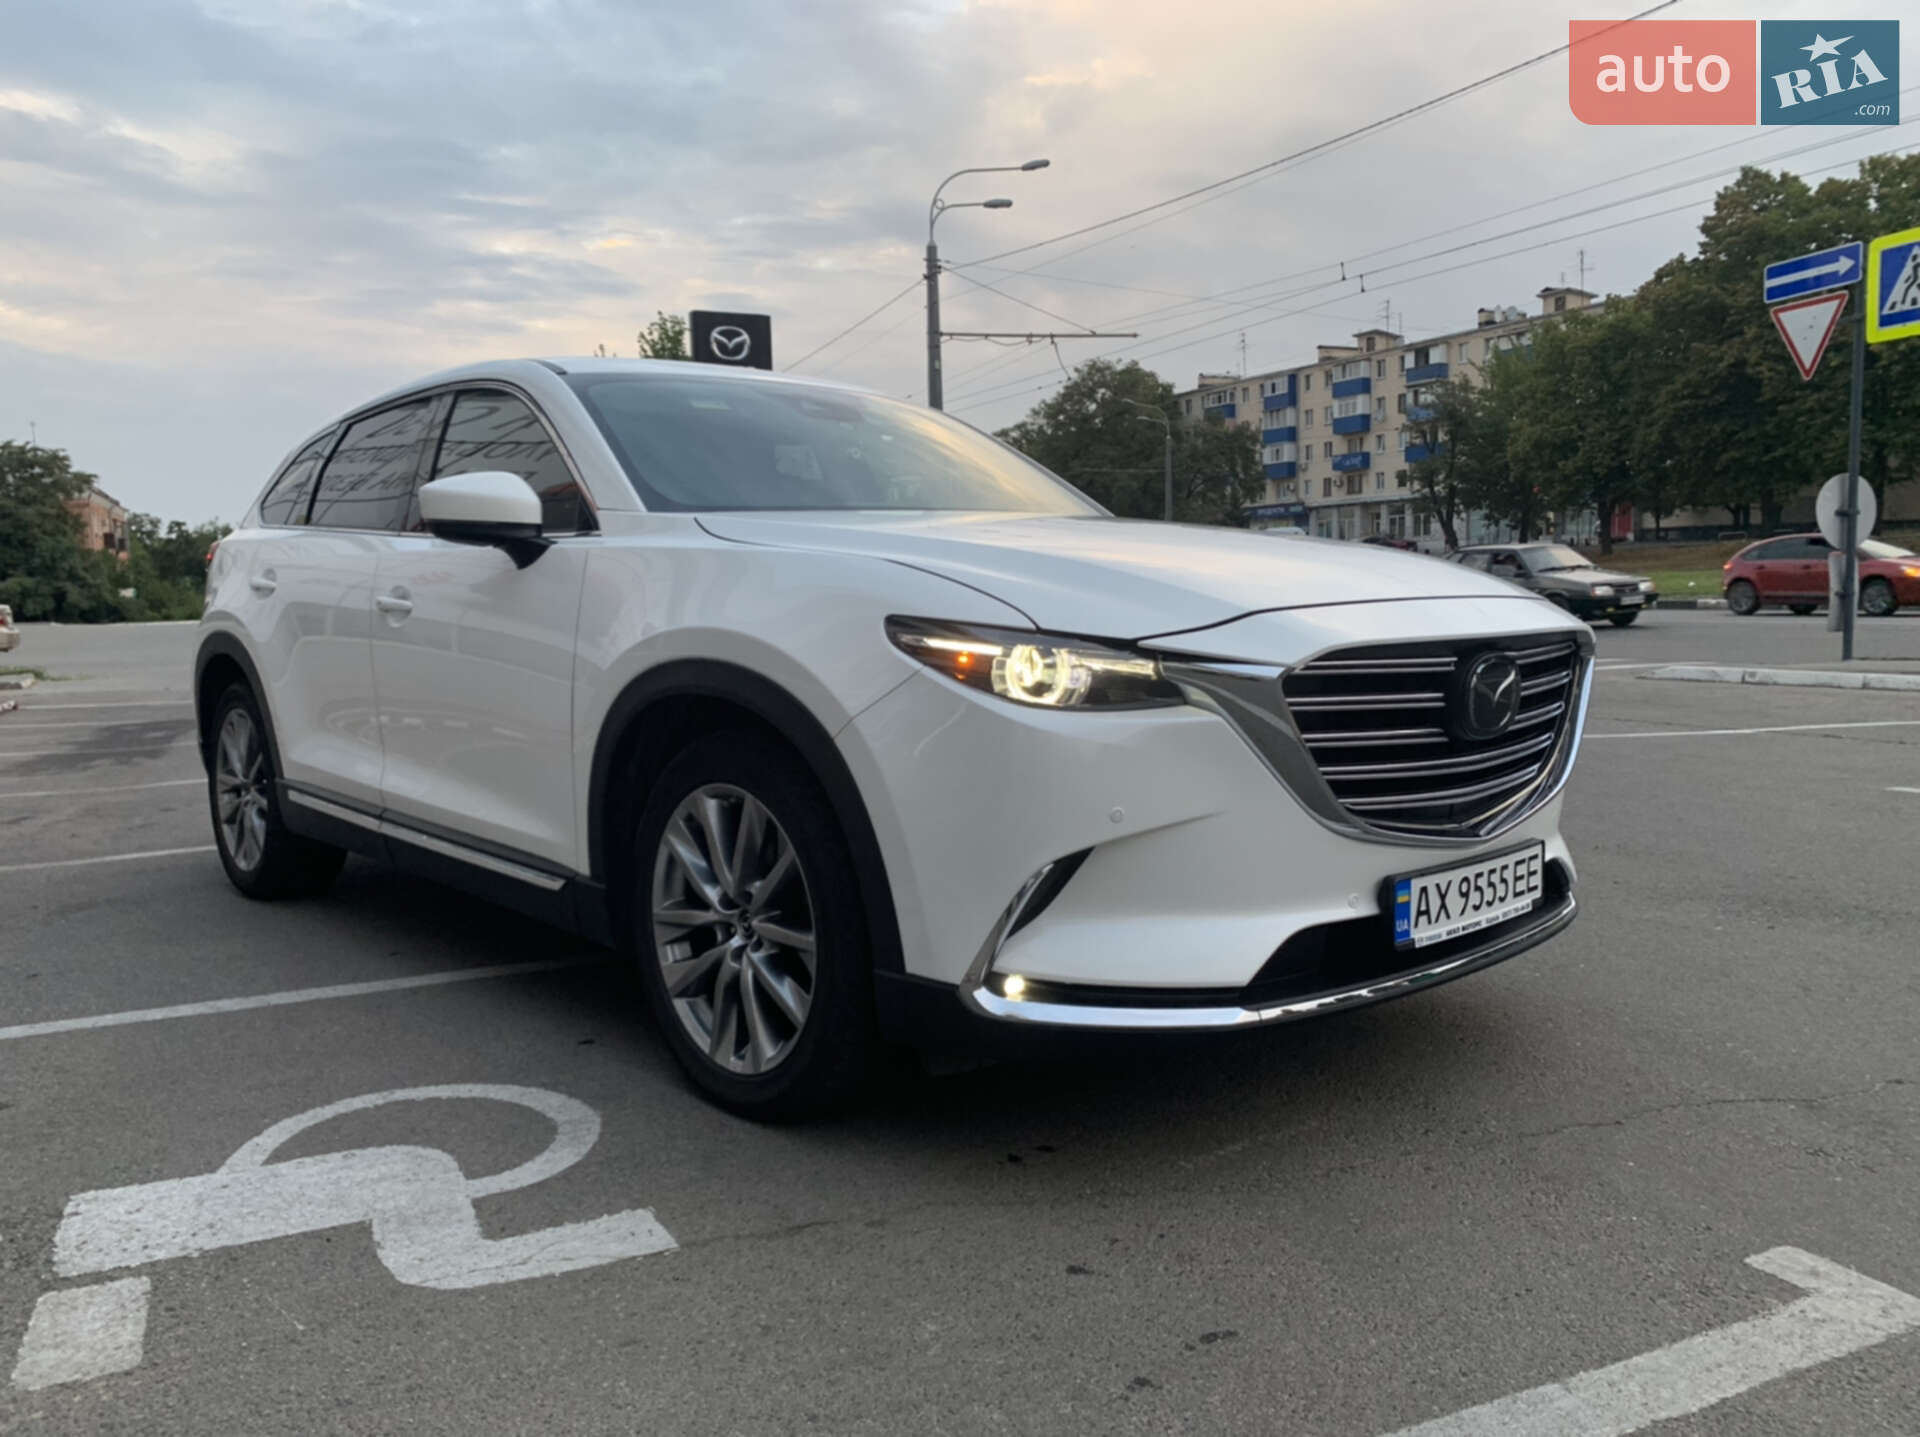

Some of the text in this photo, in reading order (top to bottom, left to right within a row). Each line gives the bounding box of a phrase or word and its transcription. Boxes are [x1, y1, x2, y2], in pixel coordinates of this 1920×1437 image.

[1414, 880, 1452, 929] AX
[1458, 864, 1509, 917] 9555
[1513, 854, 1538, 898] EE
[1396, 919, 1408, 932] UA
